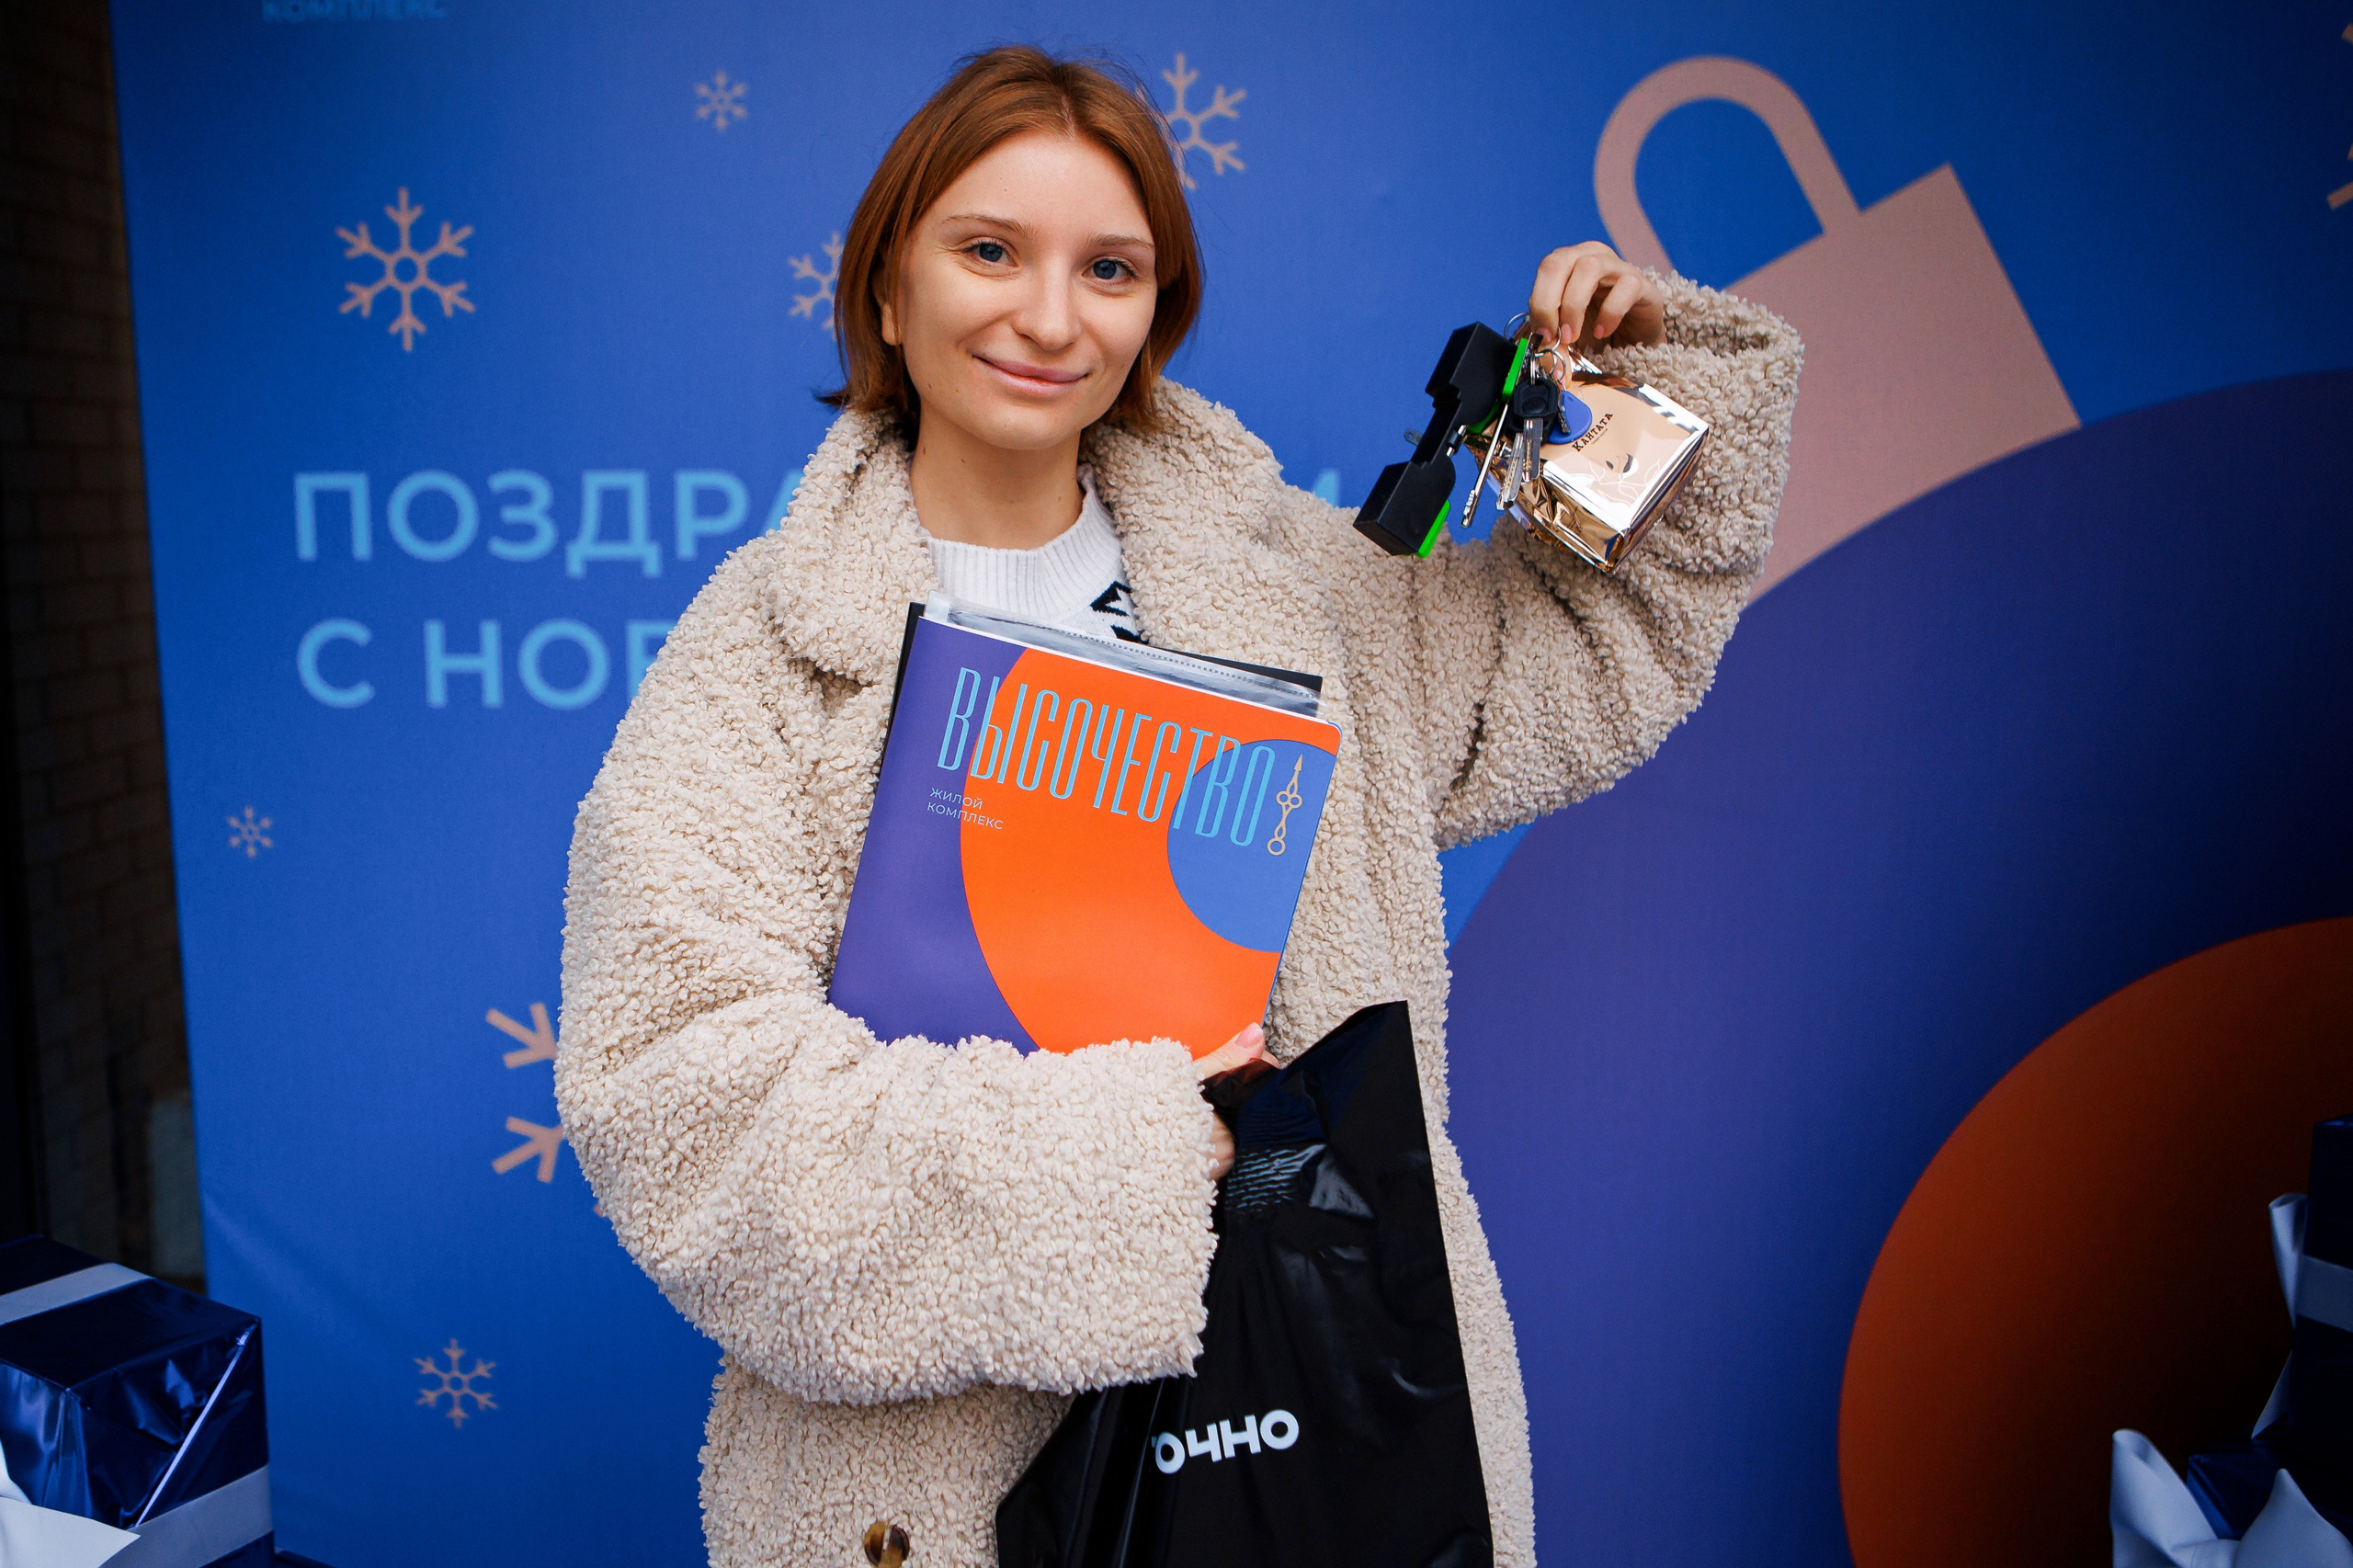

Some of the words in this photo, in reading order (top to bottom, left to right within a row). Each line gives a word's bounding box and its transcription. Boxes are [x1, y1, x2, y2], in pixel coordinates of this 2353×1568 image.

[1572, 413, 1613, 452] КАНТАТА
[297, 617, 374, 709] С
[938, 666, 1276, 846] ВЫСОЧЕСТВО
[926, 801, 1004, 830] КОМПЛЕКС
[929, 787, 983, 810] ЖИЛОЙ
[1152, 1409, 1299, 1474] ОЧНО
